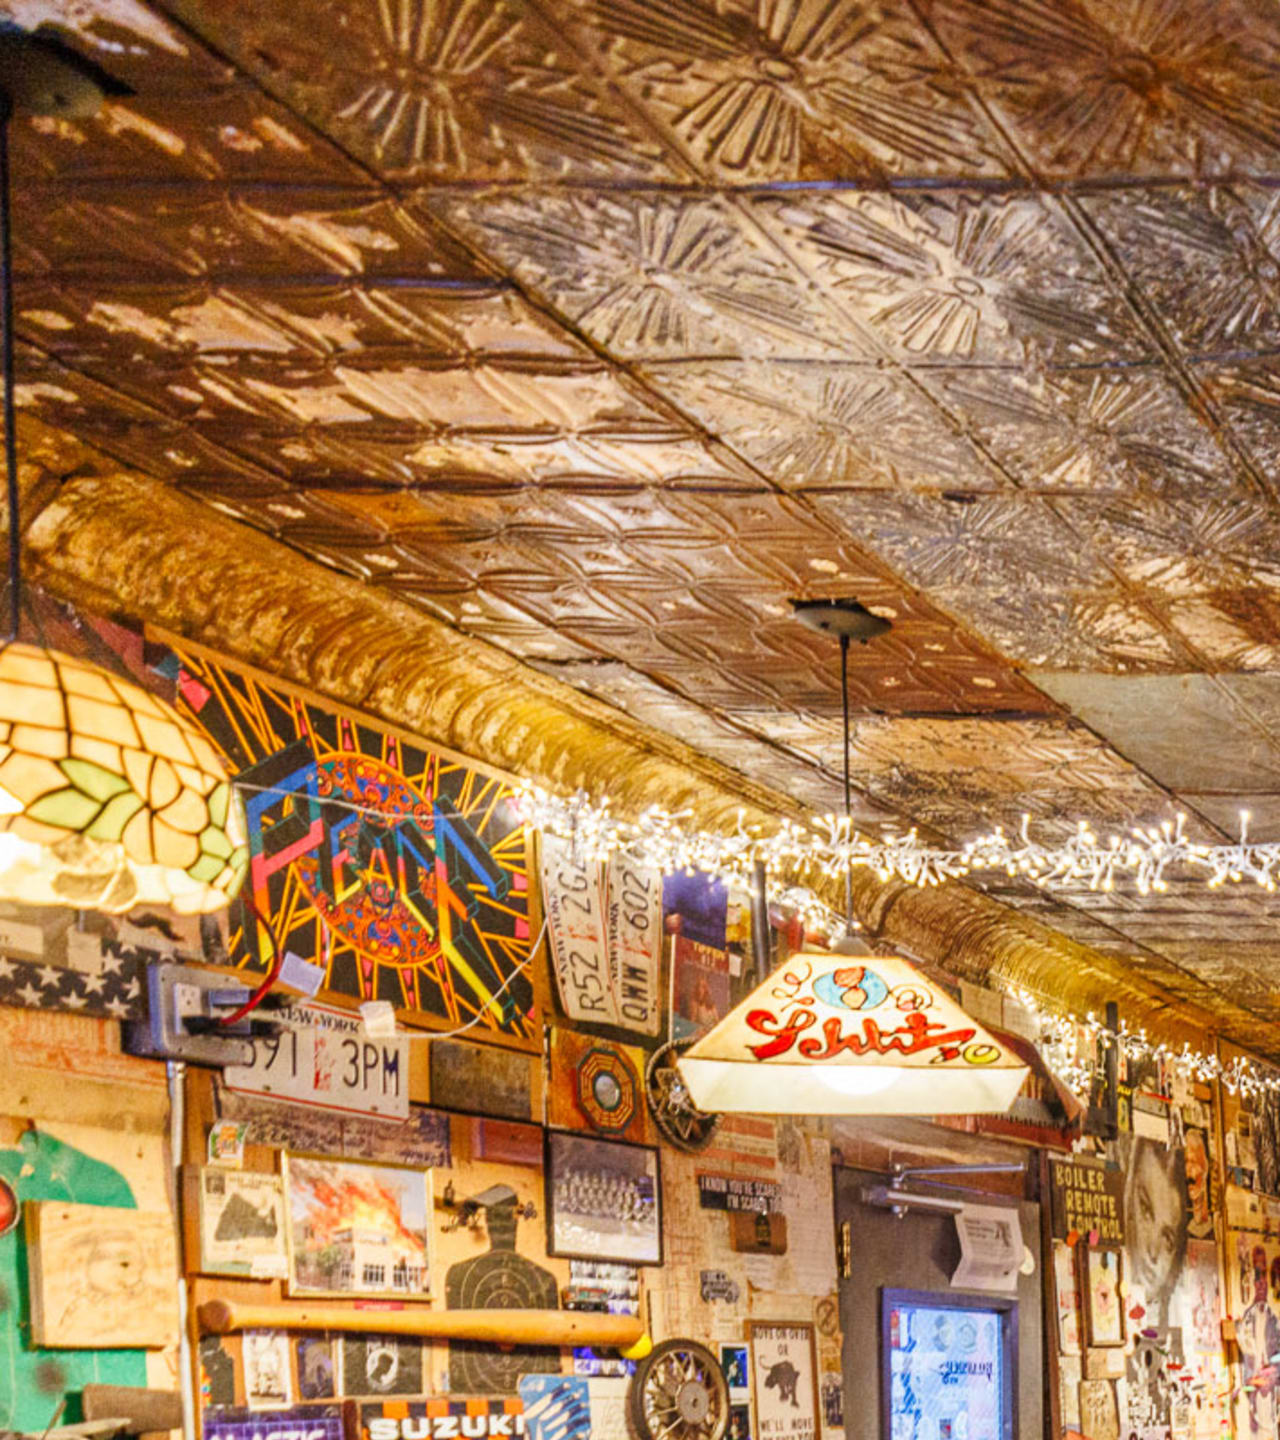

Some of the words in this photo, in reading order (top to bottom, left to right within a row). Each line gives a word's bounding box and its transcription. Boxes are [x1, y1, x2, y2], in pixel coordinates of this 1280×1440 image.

[621, 870, 650, 931] 602
[342, 1039, 399, 1097] 3PM
[1056, 1164, 1105, 1192] BOILER
[1065, 1189, 1117, 1218] REMOTE
[1066, 1213, 1123, 1240] CONTROL
